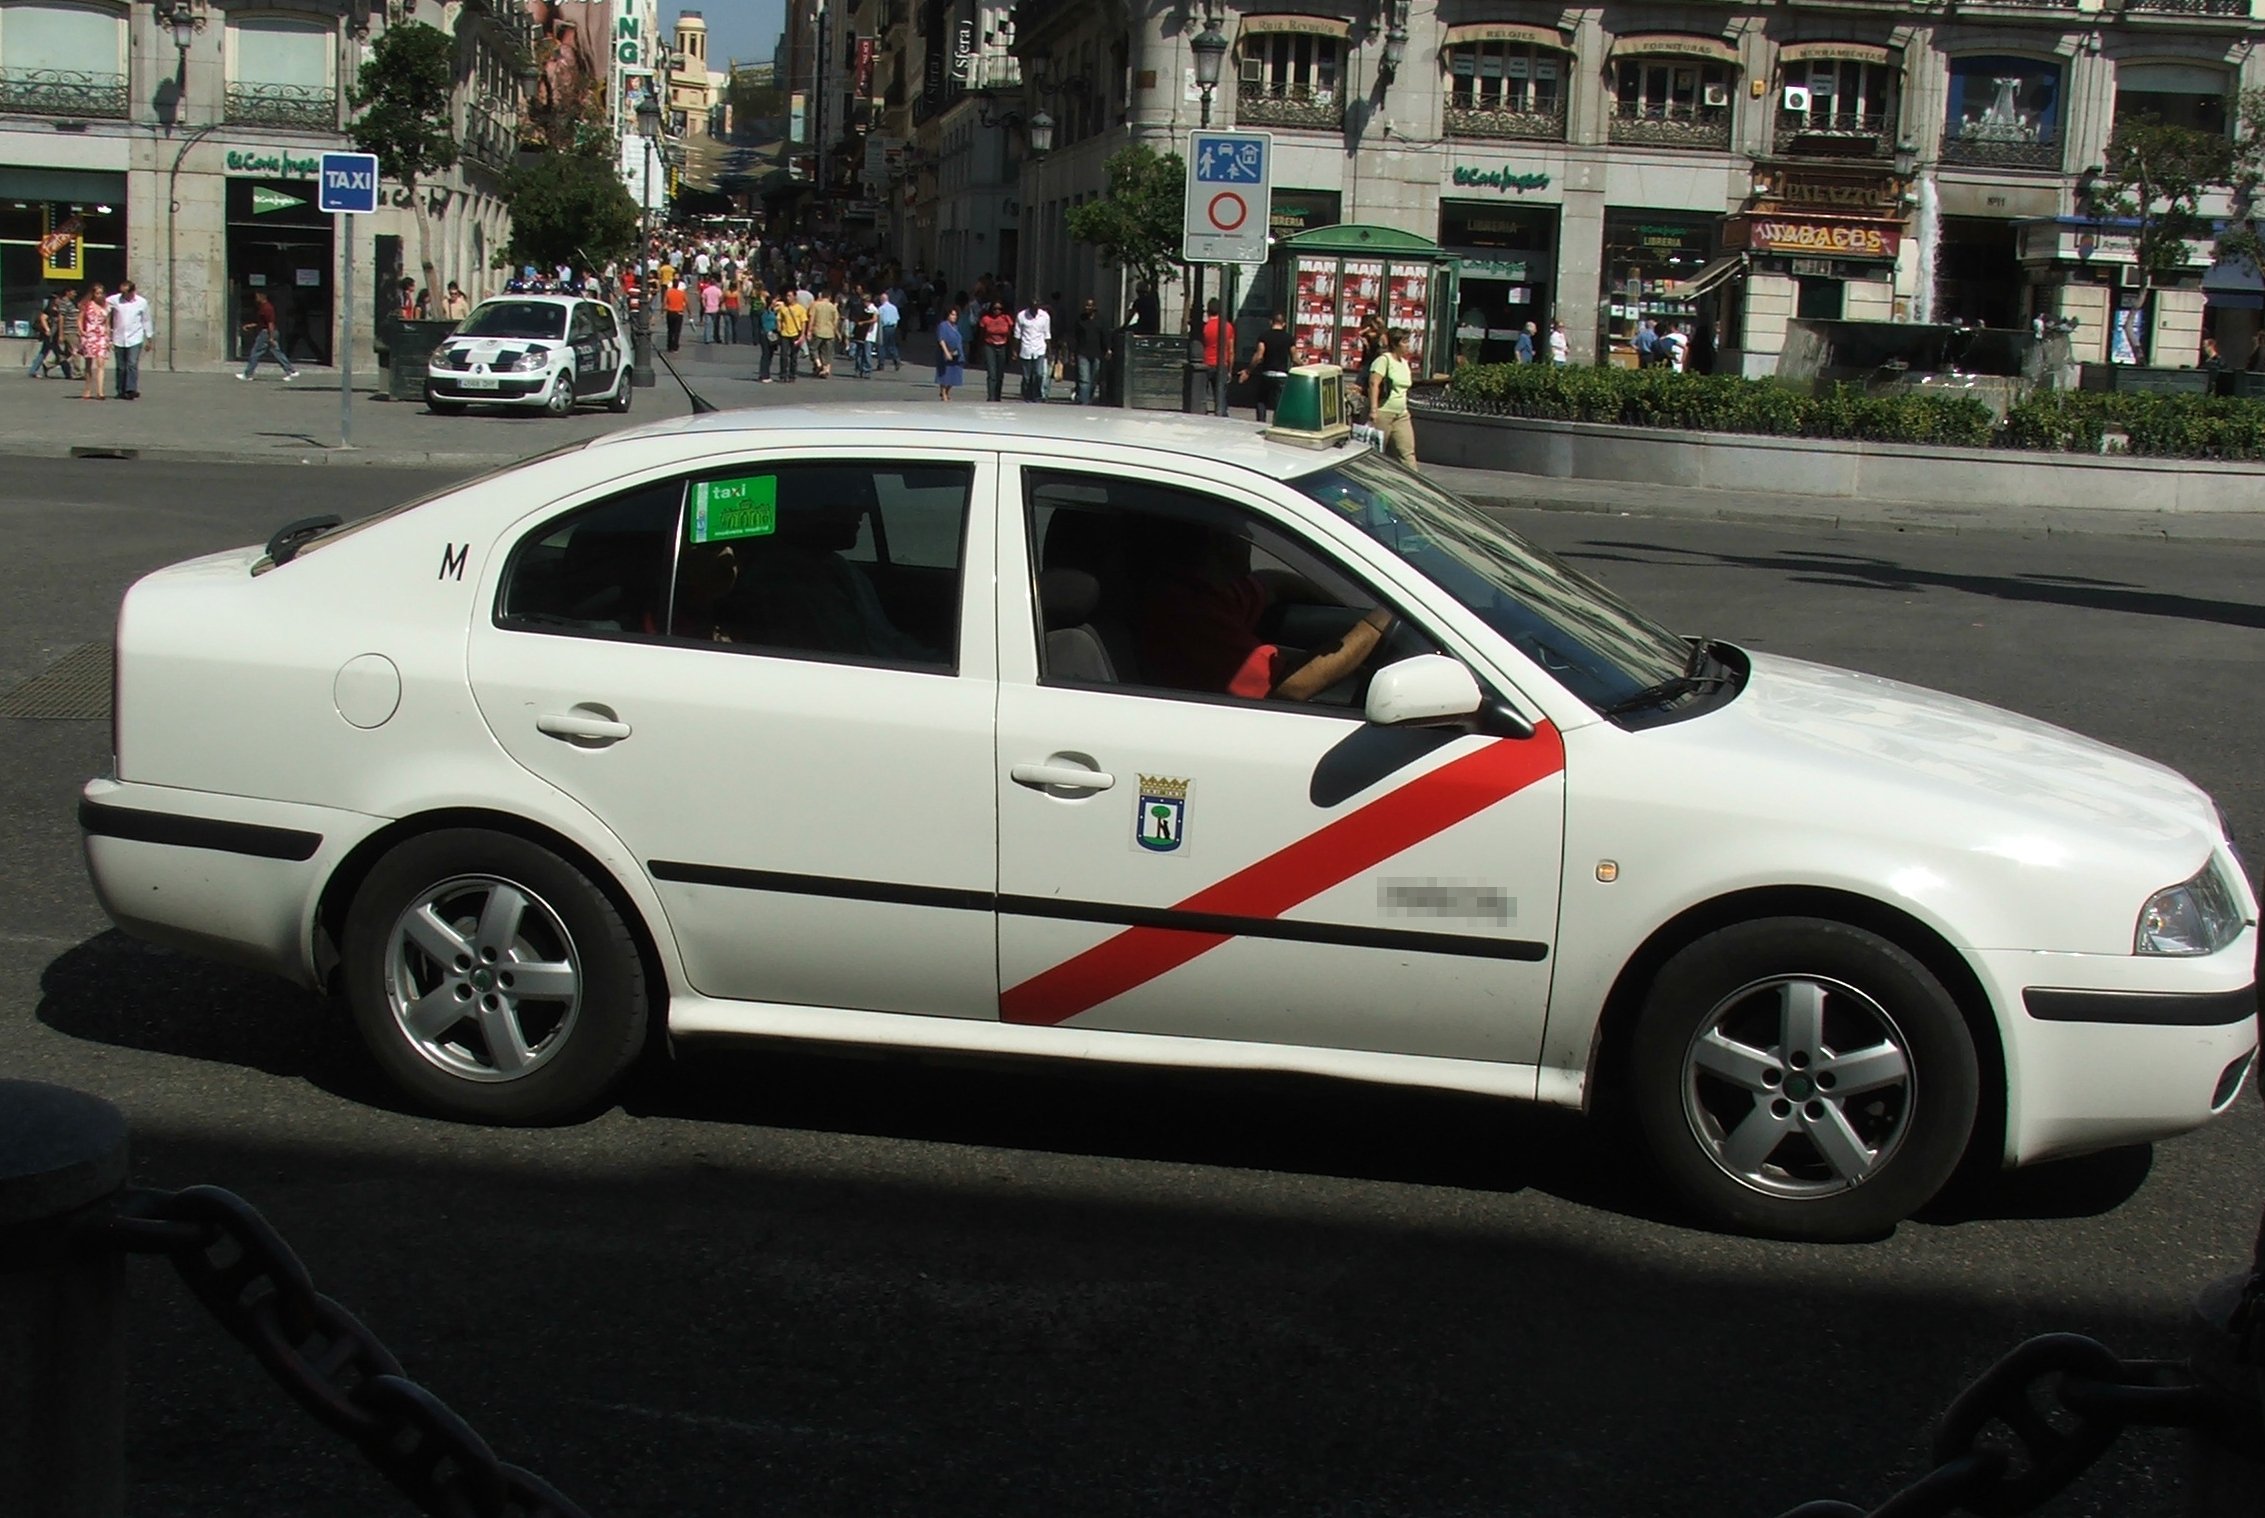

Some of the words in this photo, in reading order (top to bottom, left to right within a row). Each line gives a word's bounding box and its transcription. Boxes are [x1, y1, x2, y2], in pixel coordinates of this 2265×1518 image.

[1486, 30, 1536, 41] RELOJES
[1643, 42, 1712, 54] FORNITURAS
[325, 170, 372, 190] TAXI
[1787, 183, 1881, 206] PALAZZO
[1270, 215, 1305, 228] IBRERIA
[1769, 224, 1882, 249] TABACOS
[1299, 260, 1337, 272] MAN
[1344, 263, 1382, 275] MAN
[1390, 265, 1428, 277] MAN
[713, 483, 747, 500] taxi
[438, 542, 470, 582] M
